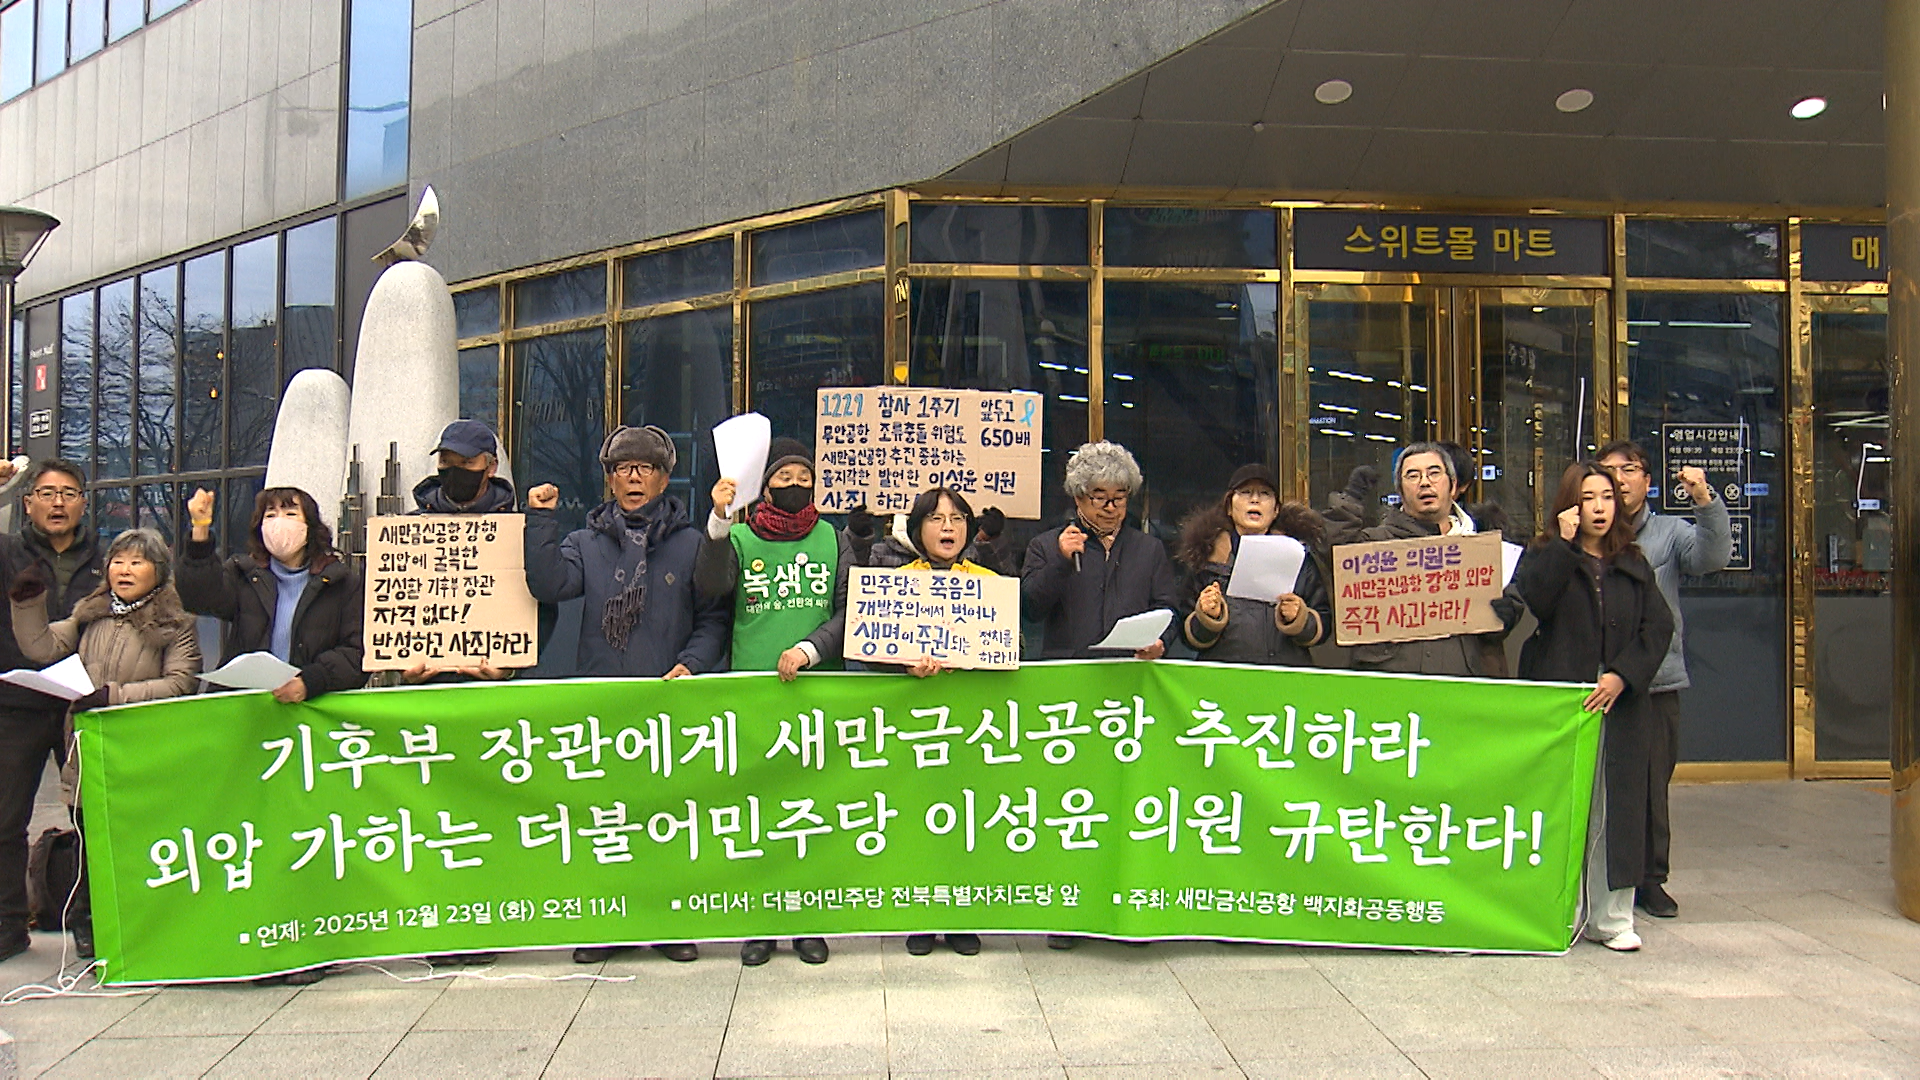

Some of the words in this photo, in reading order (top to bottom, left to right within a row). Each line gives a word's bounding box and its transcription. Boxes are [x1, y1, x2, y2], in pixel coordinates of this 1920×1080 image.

[1343, 225, 1478, 260] 스위트몰
[1493, 227, 1557, 262] 마트
[1851, 236, 1880, 269] 매
[820, 393, 864, 418] 1229
[878, 393, 911, 418] 참사
[916, 395, 960, 418] 1주기
[980, 399, 1016, 423] 앞두고
[821, 423, 870, 445] 무안공항
[878, 421, 928, 444] 조류충돌
[930, 424, 967, 444] 위험도
[980, 427, 1031, 448] 650배
[821, 446, 887, 466] 새만금신공항
[889, 445, 916, 466] 추진
[877, 468, 920, 488] 발언한
[929, 469, 977, 494] 이성윤
[983, 471, 1016, 495] 의원
[821, 489, 868, 511] 사죄
[875, 490, 920, 511] 하라
[378, 522, 461, 546] 새만금신공항
[465, 520, 497, 543] 강행
[377, 551, 427, 572] 외압에
[433, 546, 479, 572] 굴복한
[1342, 550, 1398, 574] 이성윤
[1406, 544, 1462, 571] 의원은
[427, 576, 459, 599] 기후부
[463, 575, 496, 598] 장관
[743, 562, 831, 599] 녹색당
[860, 575, 921, 596] 민주당은
[929, 575, 981, 600] 죽음의
[1341, 573, 1422, 600] 새만금신공항
[1425, 568, 1460, 594] 강행
[1465, 565, 1495, 588] 외압
[373, 605, 416, 626] 자격
[422, 603, 472, 626] 없다!
[856, 599, 944, 619] 개발주의에서
[951, 603, 997, 624] 벗어나
[1341, 605, 1380, 636] 즉각
[1386, 597, 1471, 629] 사과하라!
[373, 631, 444, 660] 반성하고
[449, 631, 533, 659] 사죄하라
[978, 629, 1013, 648] 정치를
[261, 722, 455, 791] 기후부
[480, 711, 737, 783] 장관에게
[766, 696, 1155, 770] 새만금신공항
[1176, 700, 1431, 778] 추진하라
[146, 822, 262, 893] 외압
[290, 808, 492, 879] 가하는
[517, 792, 898, 864] 더불어민주당
[926, 787, 1109, 852] 이성윤
[1129, 787, 1242, 854] 의원
[1270, 800, 1543, 869] 규탄한다!
[689, 892, 755, 914] 어디서:
[763, 888, 885, 911] 더불어민주당
[892, 884, 1054, 907] 전북특별자치도당
[1061, 885, 1080, 906] 앞
[1129, 888, 1169, 911] 주최:
[1176, 888, 1297, 915] 새만금신공항
[1304, 896, 1445, 923] 백지화공동행동
[257, 920, 305, 947] 언제:
[314, 910, 388, 935] 2025년
[396, 904, 439, 927] 12월
[446, 902, 491, 924] 23일
[499, 900, 535, 921] (화)
[542, 898, 582, 919] 오전
[590, 896, 626, 917] 11시
